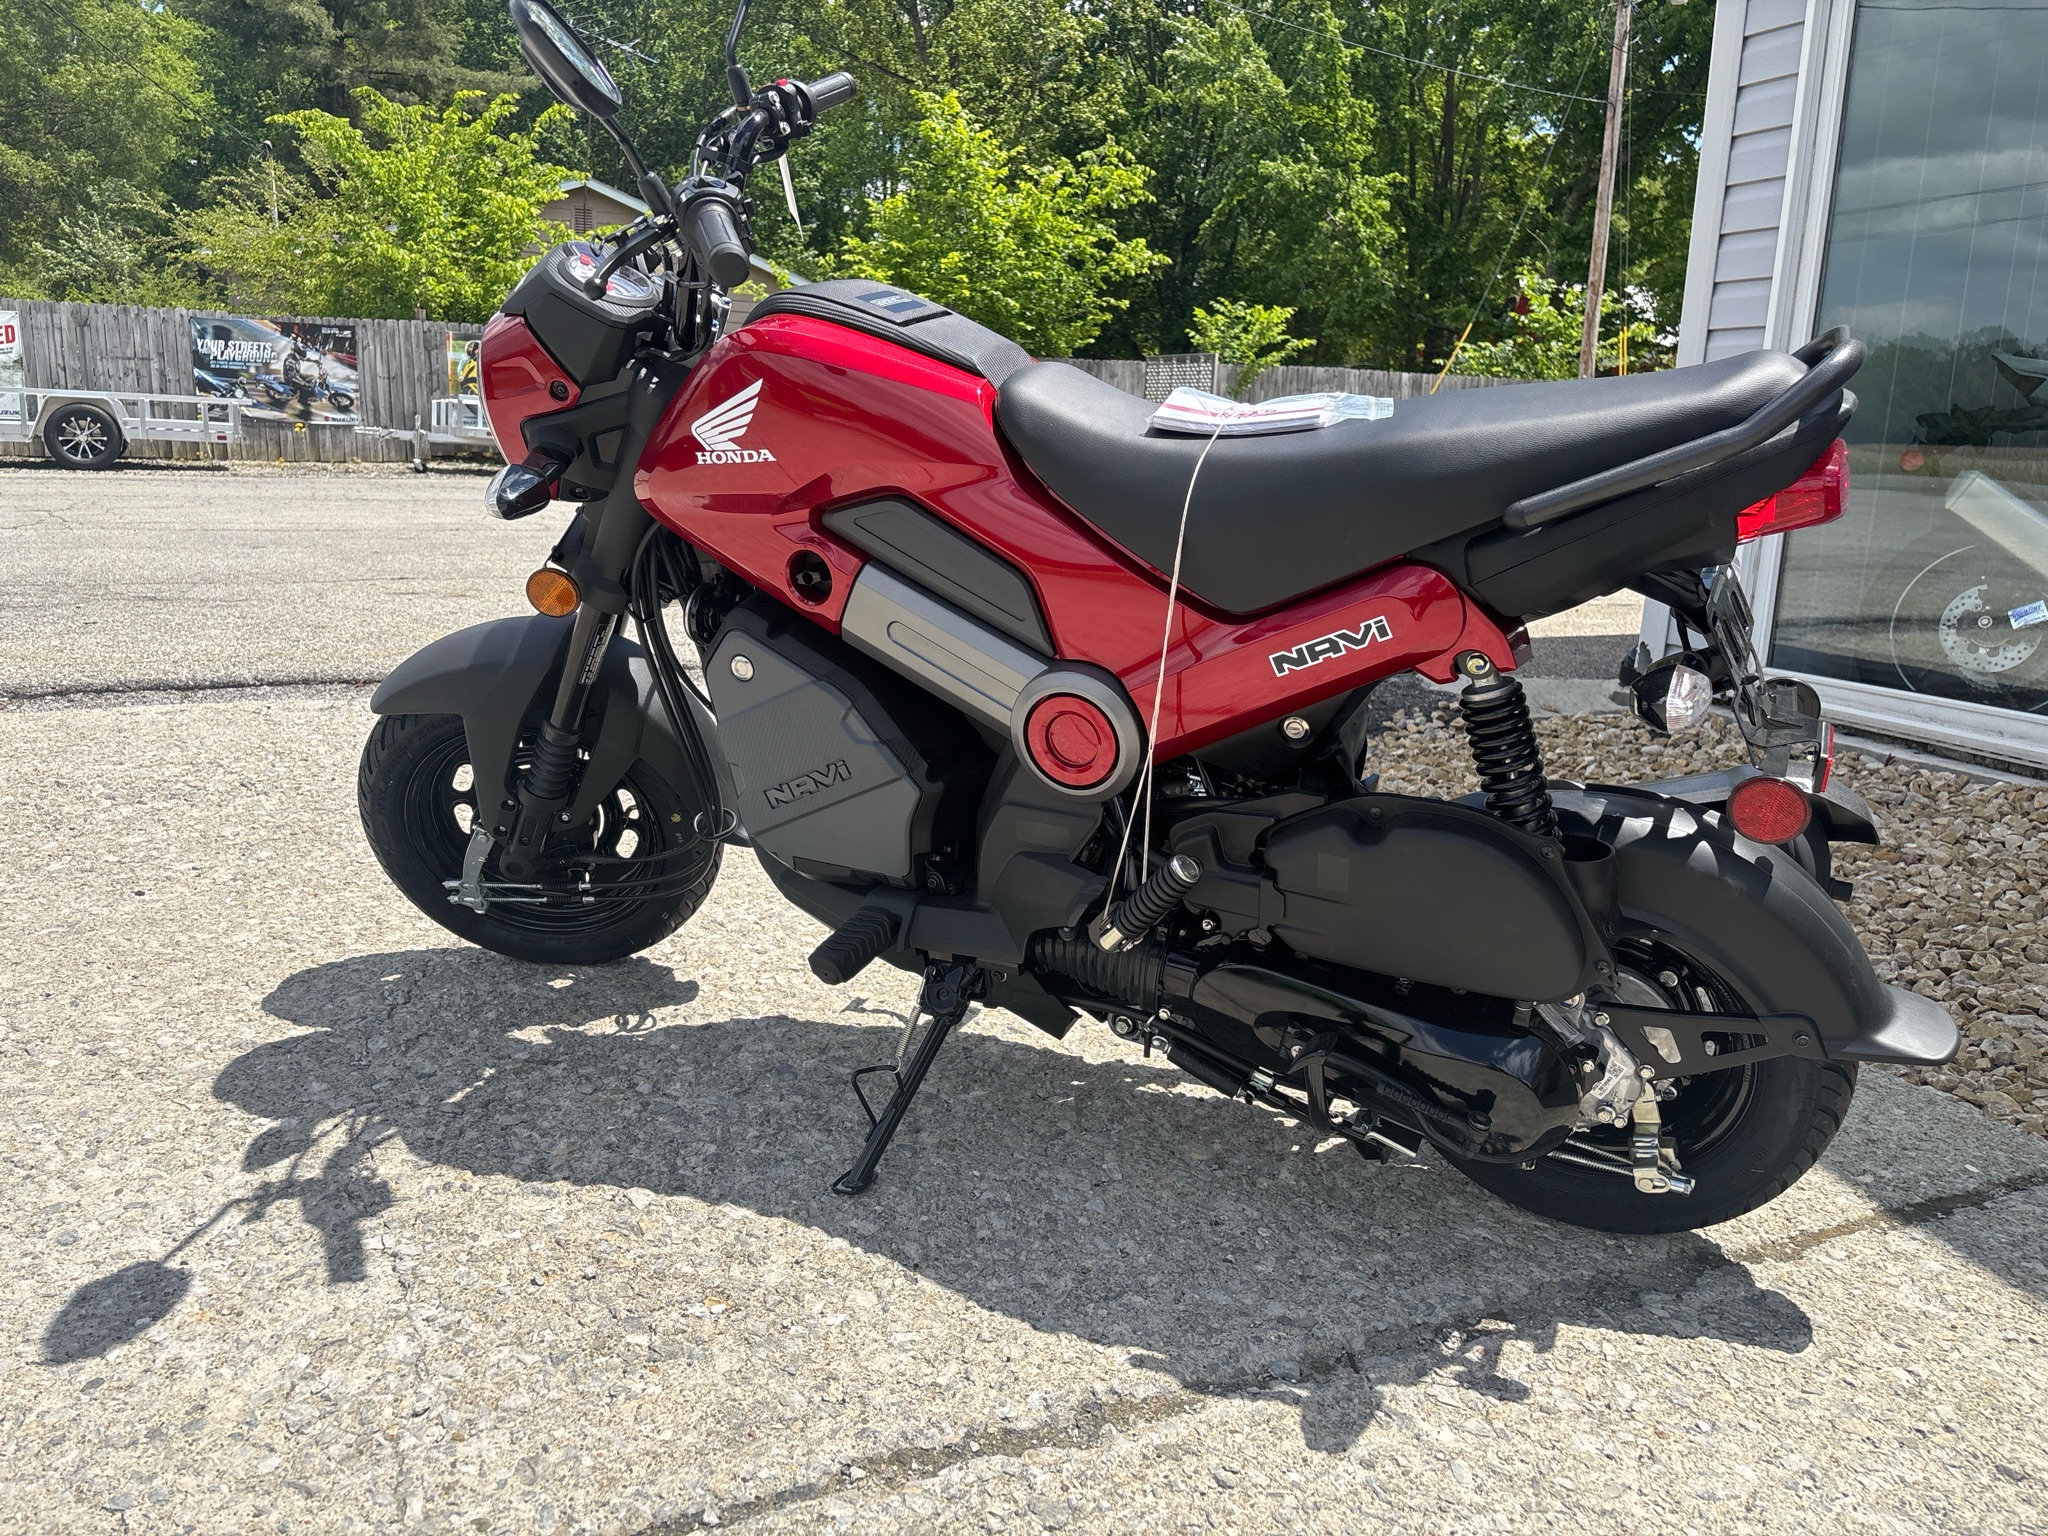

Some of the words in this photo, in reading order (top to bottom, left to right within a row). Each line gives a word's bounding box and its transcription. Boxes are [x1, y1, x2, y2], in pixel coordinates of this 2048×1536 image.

[196, 338, 225, 352] YOUR
[227, 340, 273, 353] STREETS
[209, 349, 279, 364] PLAYGROUND
[695, 448, 777, 465] HONDA
